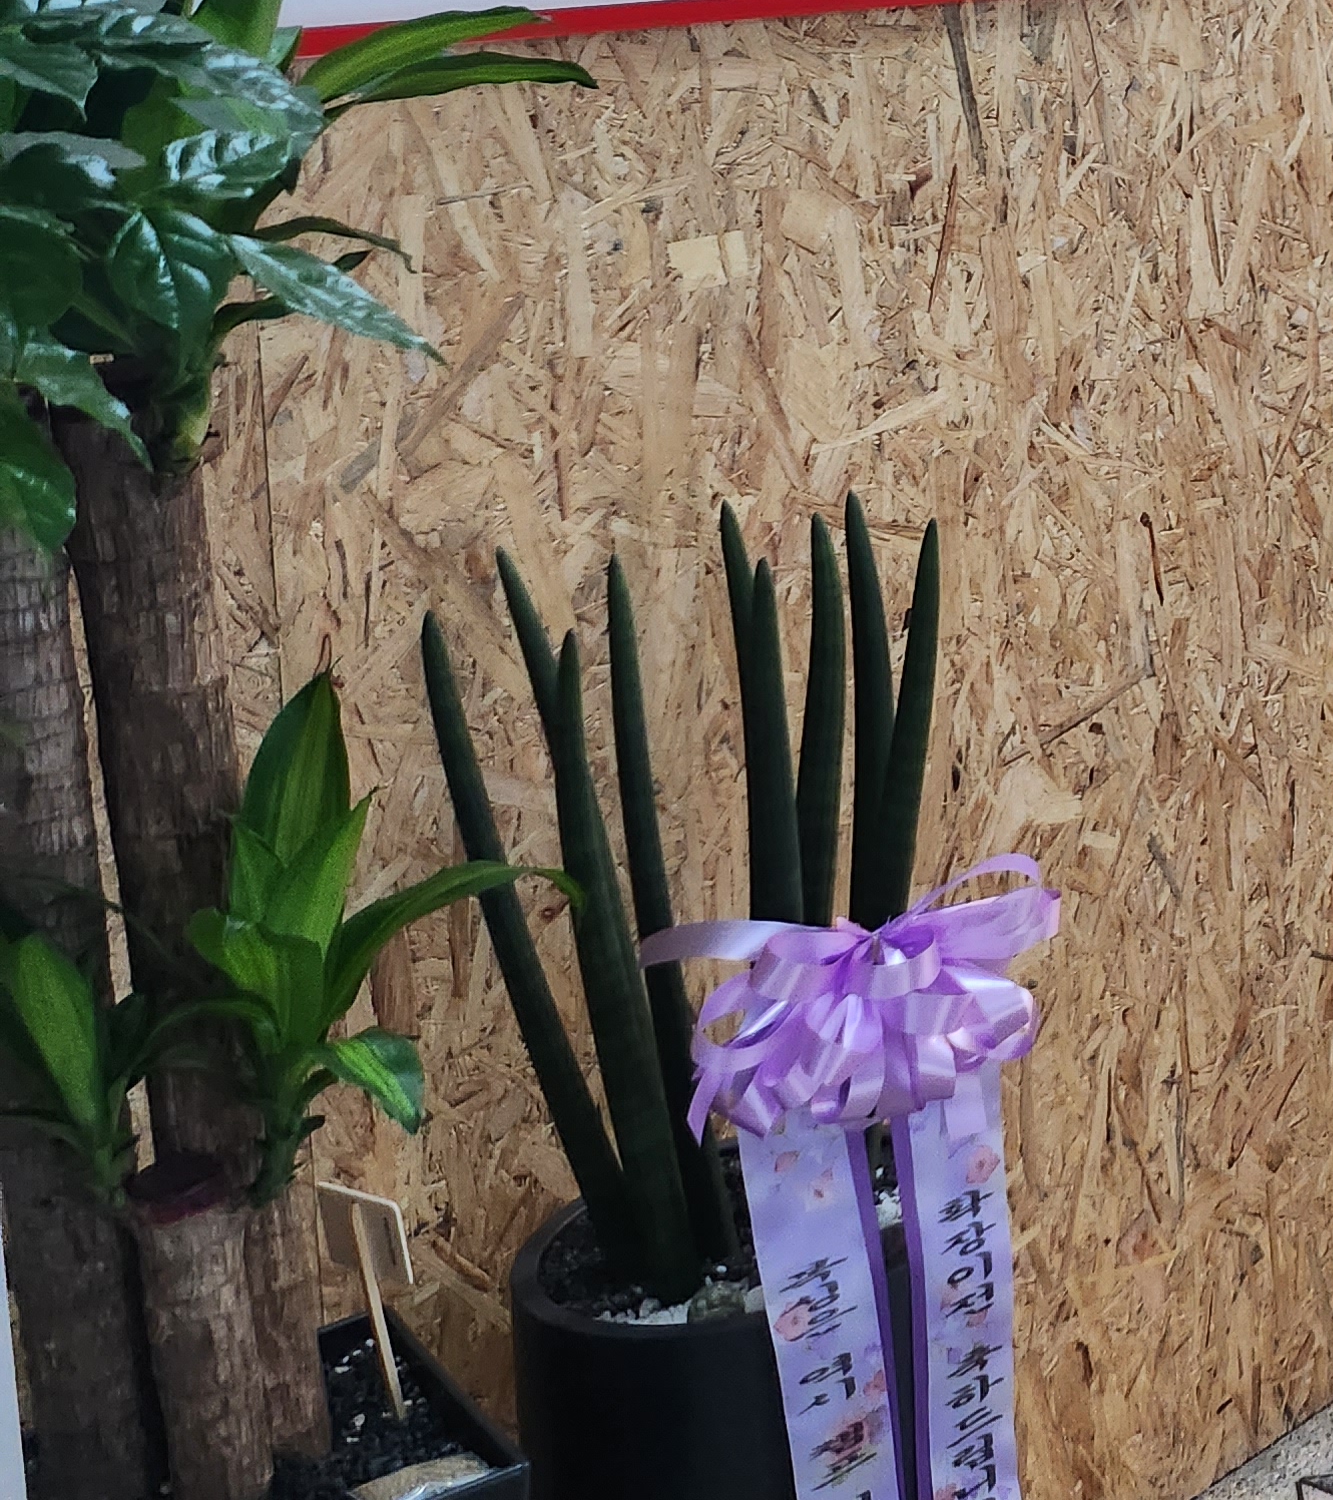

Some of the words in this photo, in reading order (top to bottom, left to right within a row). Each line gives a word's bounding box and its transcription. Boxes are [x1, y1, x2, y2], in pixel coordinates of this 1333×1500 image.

[938, 1189, 997, 1318] 확장이전
[798, 1352, 857, 1416] 역시
[946, 1341, 1004, 1500] 축하드립니
